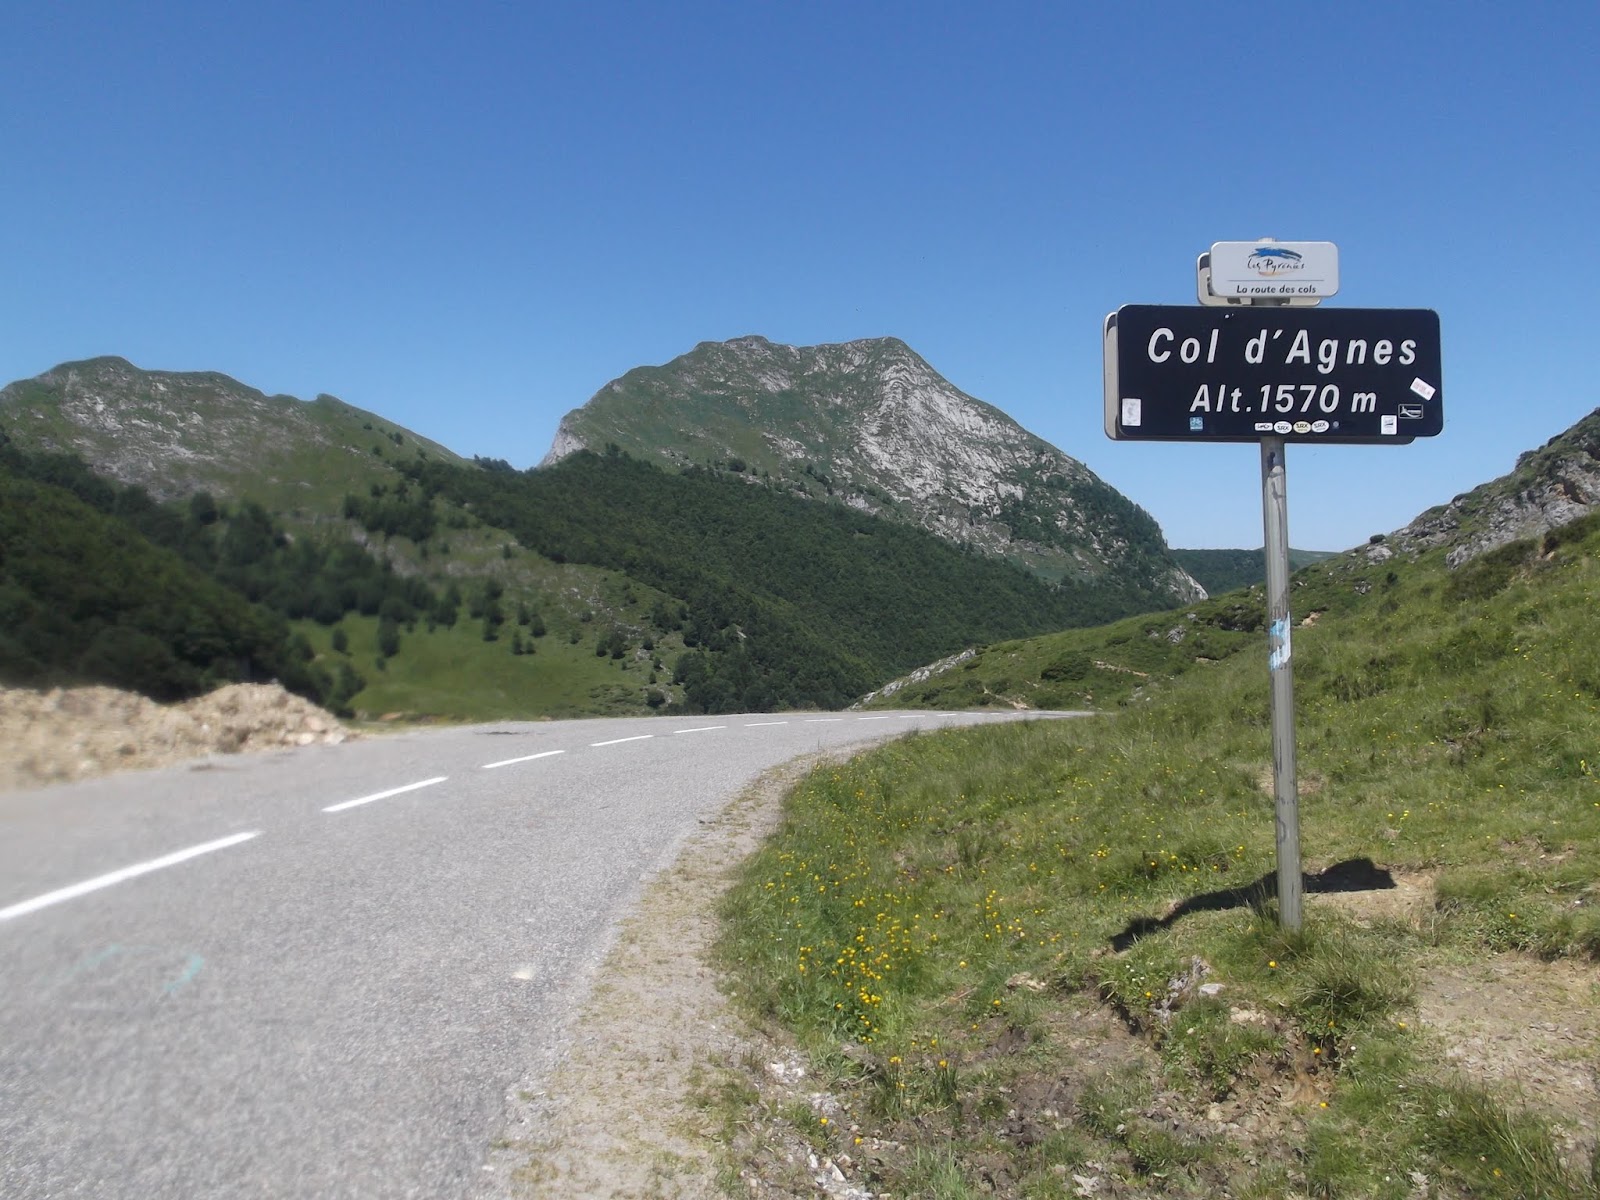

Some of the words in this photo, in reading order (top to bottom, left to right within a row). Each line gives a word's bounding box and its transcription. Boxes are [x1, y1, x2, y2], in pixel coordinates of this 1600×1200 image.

[1247, 258, 1261, 270] Les
[1236, 284, 1248, 294] La
[1250, 286, 1276, 294] route
[1279, 284, 1295, 294] des
[1298, 284, 1317, 294] cols
[1148, 327, 1219, 364] Col
[1244, 329, 1417, 374] d'Agnes
[1351, 391, 1377, 413] m
